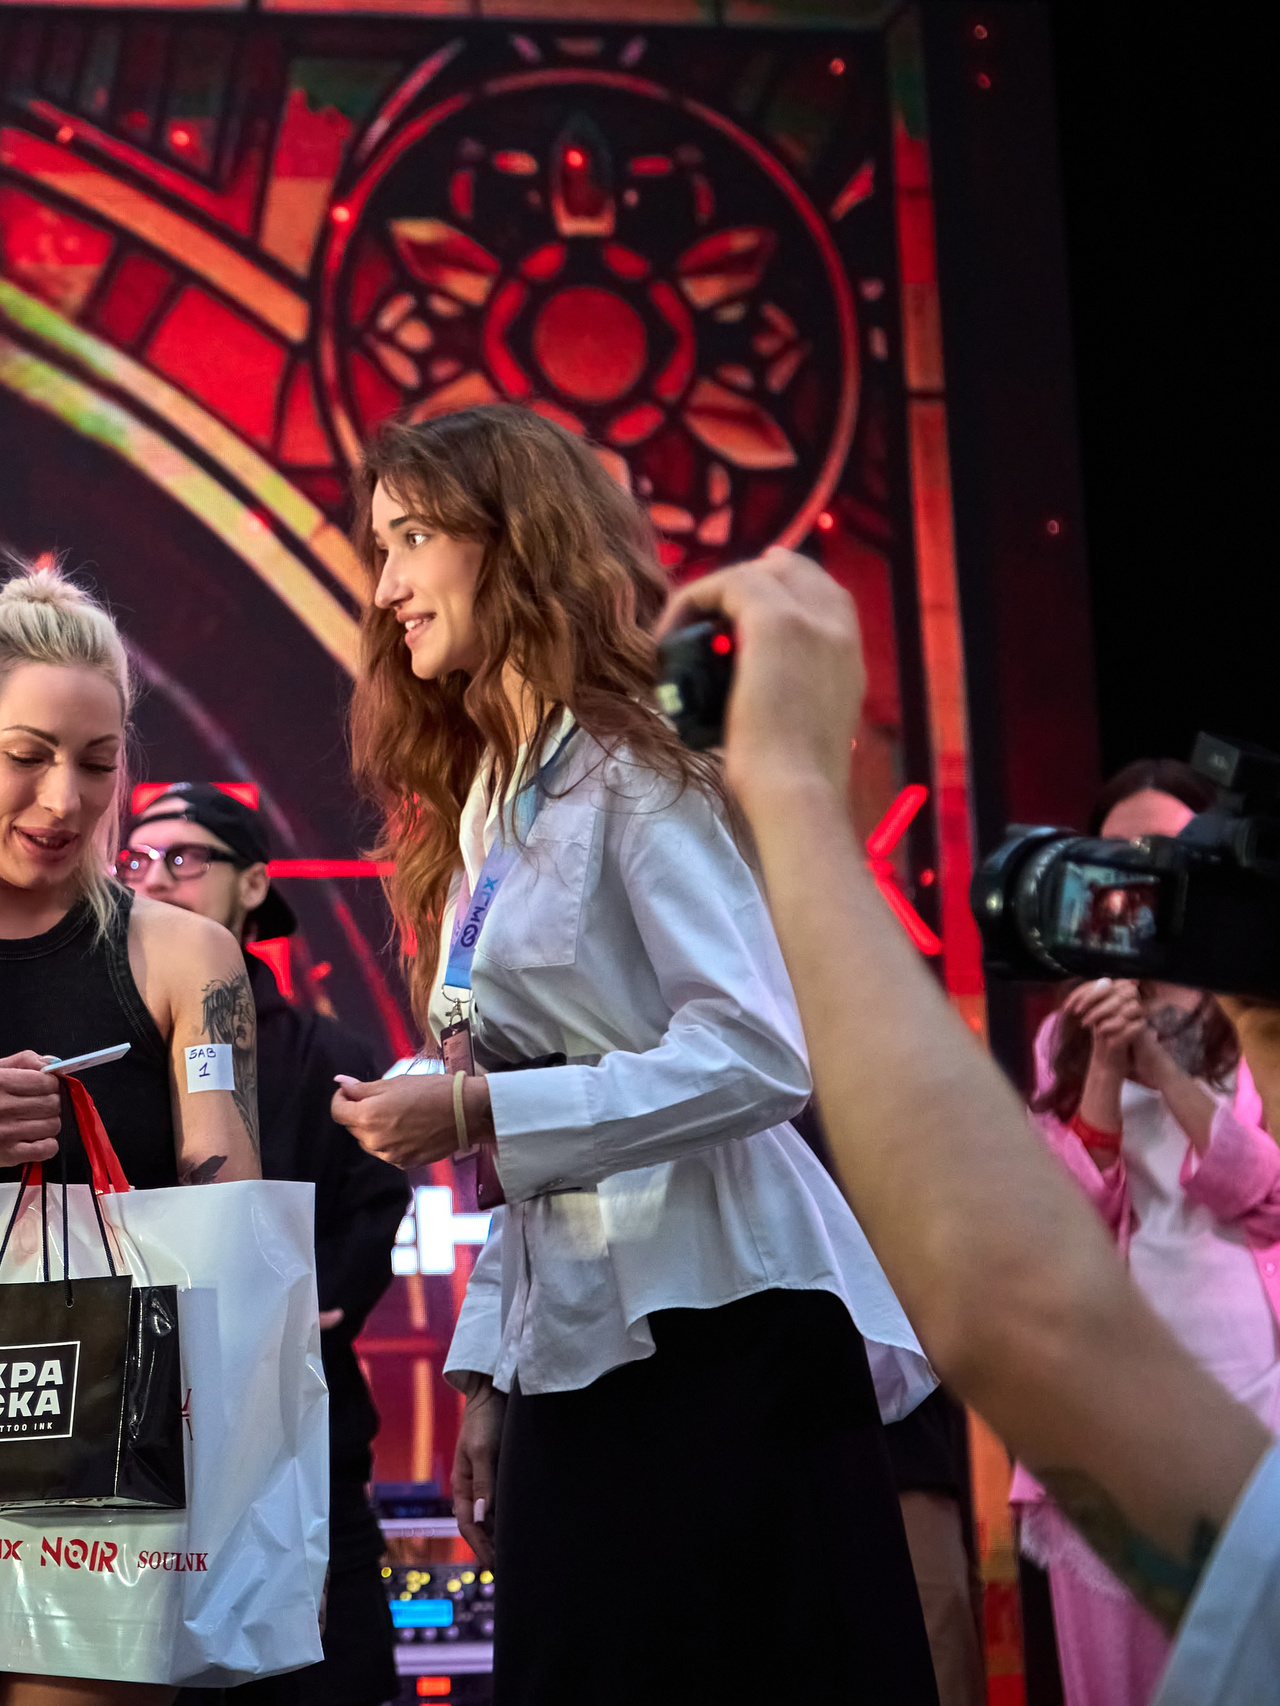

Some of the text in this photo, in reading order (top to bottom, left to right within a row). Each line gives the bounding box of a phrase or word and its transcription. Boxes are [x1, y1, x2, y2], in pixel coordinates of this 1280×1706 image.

[199, 1062, 211, 1077] 1
[34, 1422, 53, 1431] INK
[40, 1536, 118, 1573] NOIR
